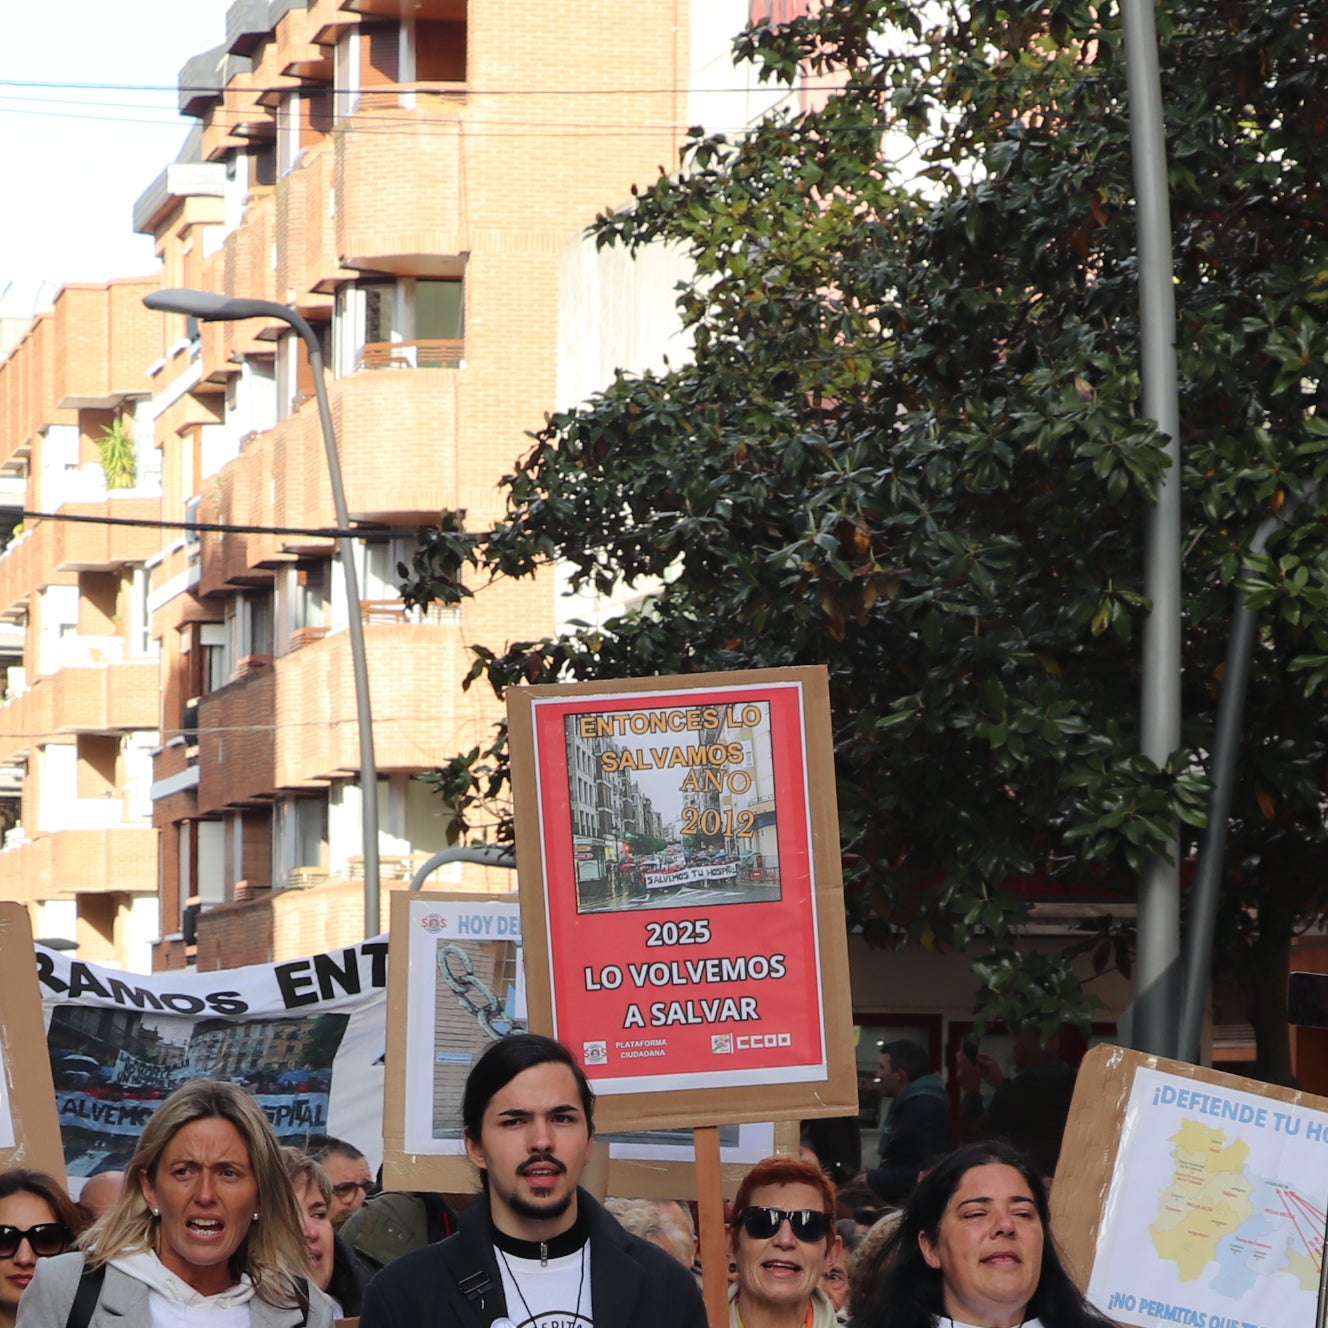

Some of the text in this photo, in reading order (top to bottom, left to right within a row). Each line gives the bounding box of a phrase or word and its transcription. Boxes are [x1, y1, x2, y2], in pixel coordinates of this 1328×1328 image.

[579, 705, 762, 738] ENTONCES LO
[601, 742, 745, 772] SALVAMOS
[679, 764, 752, 794] AÑO
[680, 807, 756, 838] 2012
[458, 915, 493, 935] HOY
[497, 916, 522, 935] DE
[645, 919, 712, 947] 2025
[584, 954, 787, 991] LO VOLVEMOS
[623, 997, 762, 1029] A SALVAR
[615, 1038, 668, 1049] PLATAFORMA
[620, 1049, 666, 1059] CIUDADANA
[737, 1032, 792, 1050] CCOO
[1153, 1085, 1267, 1129] ¡DEFIENDE
[1273, 1112, 1300, 1135] TU
[1108, 1291, 1137, 1312] ¡NO
